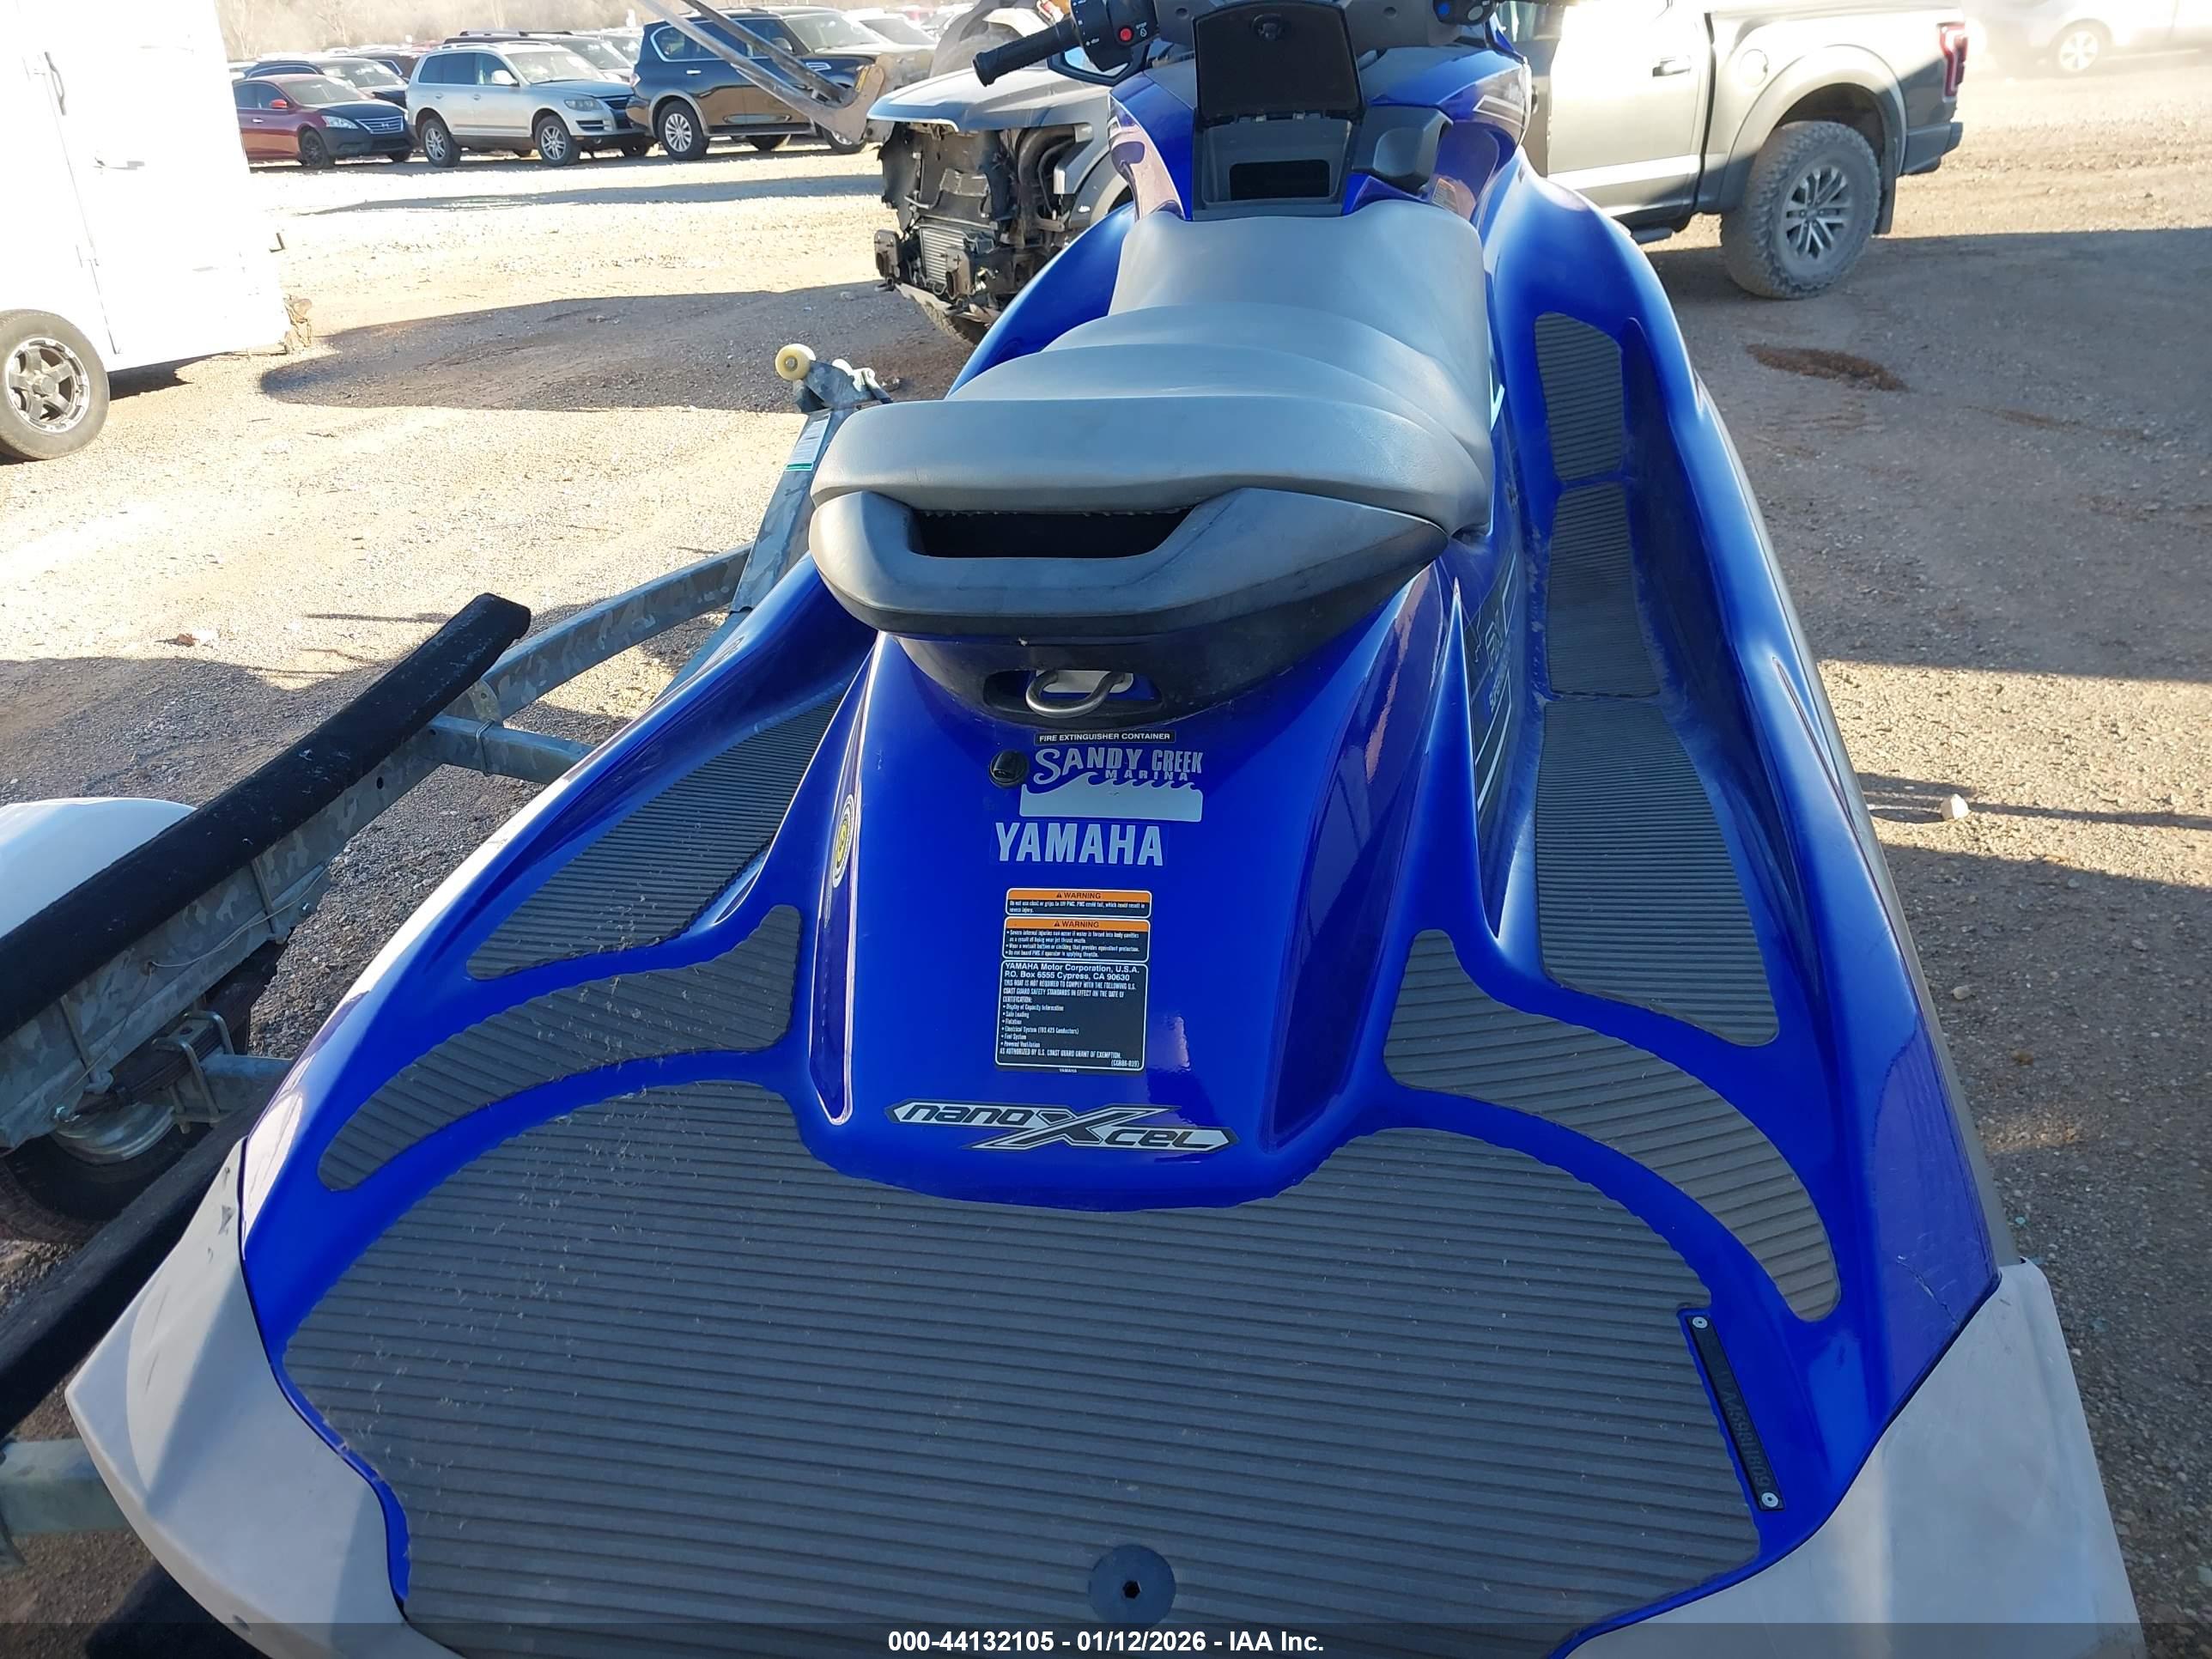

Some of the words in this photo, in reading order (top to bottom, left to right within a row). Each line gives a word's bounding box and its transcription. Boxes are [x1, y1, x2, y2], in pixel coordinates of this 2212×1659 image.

[1033, 747, 1143, 785] SANDY
[1152, 750, 1203, 773] CREEK
[1105, 769, 1188, 781] MARINA
[996, 823, 1163, 866] YAMAHA
[1065, 963, 1113, 973] Corporation,
[1115, 965, 1139, 974] U.S.A.
[1057, 972, 1091, 981] Cypress,
